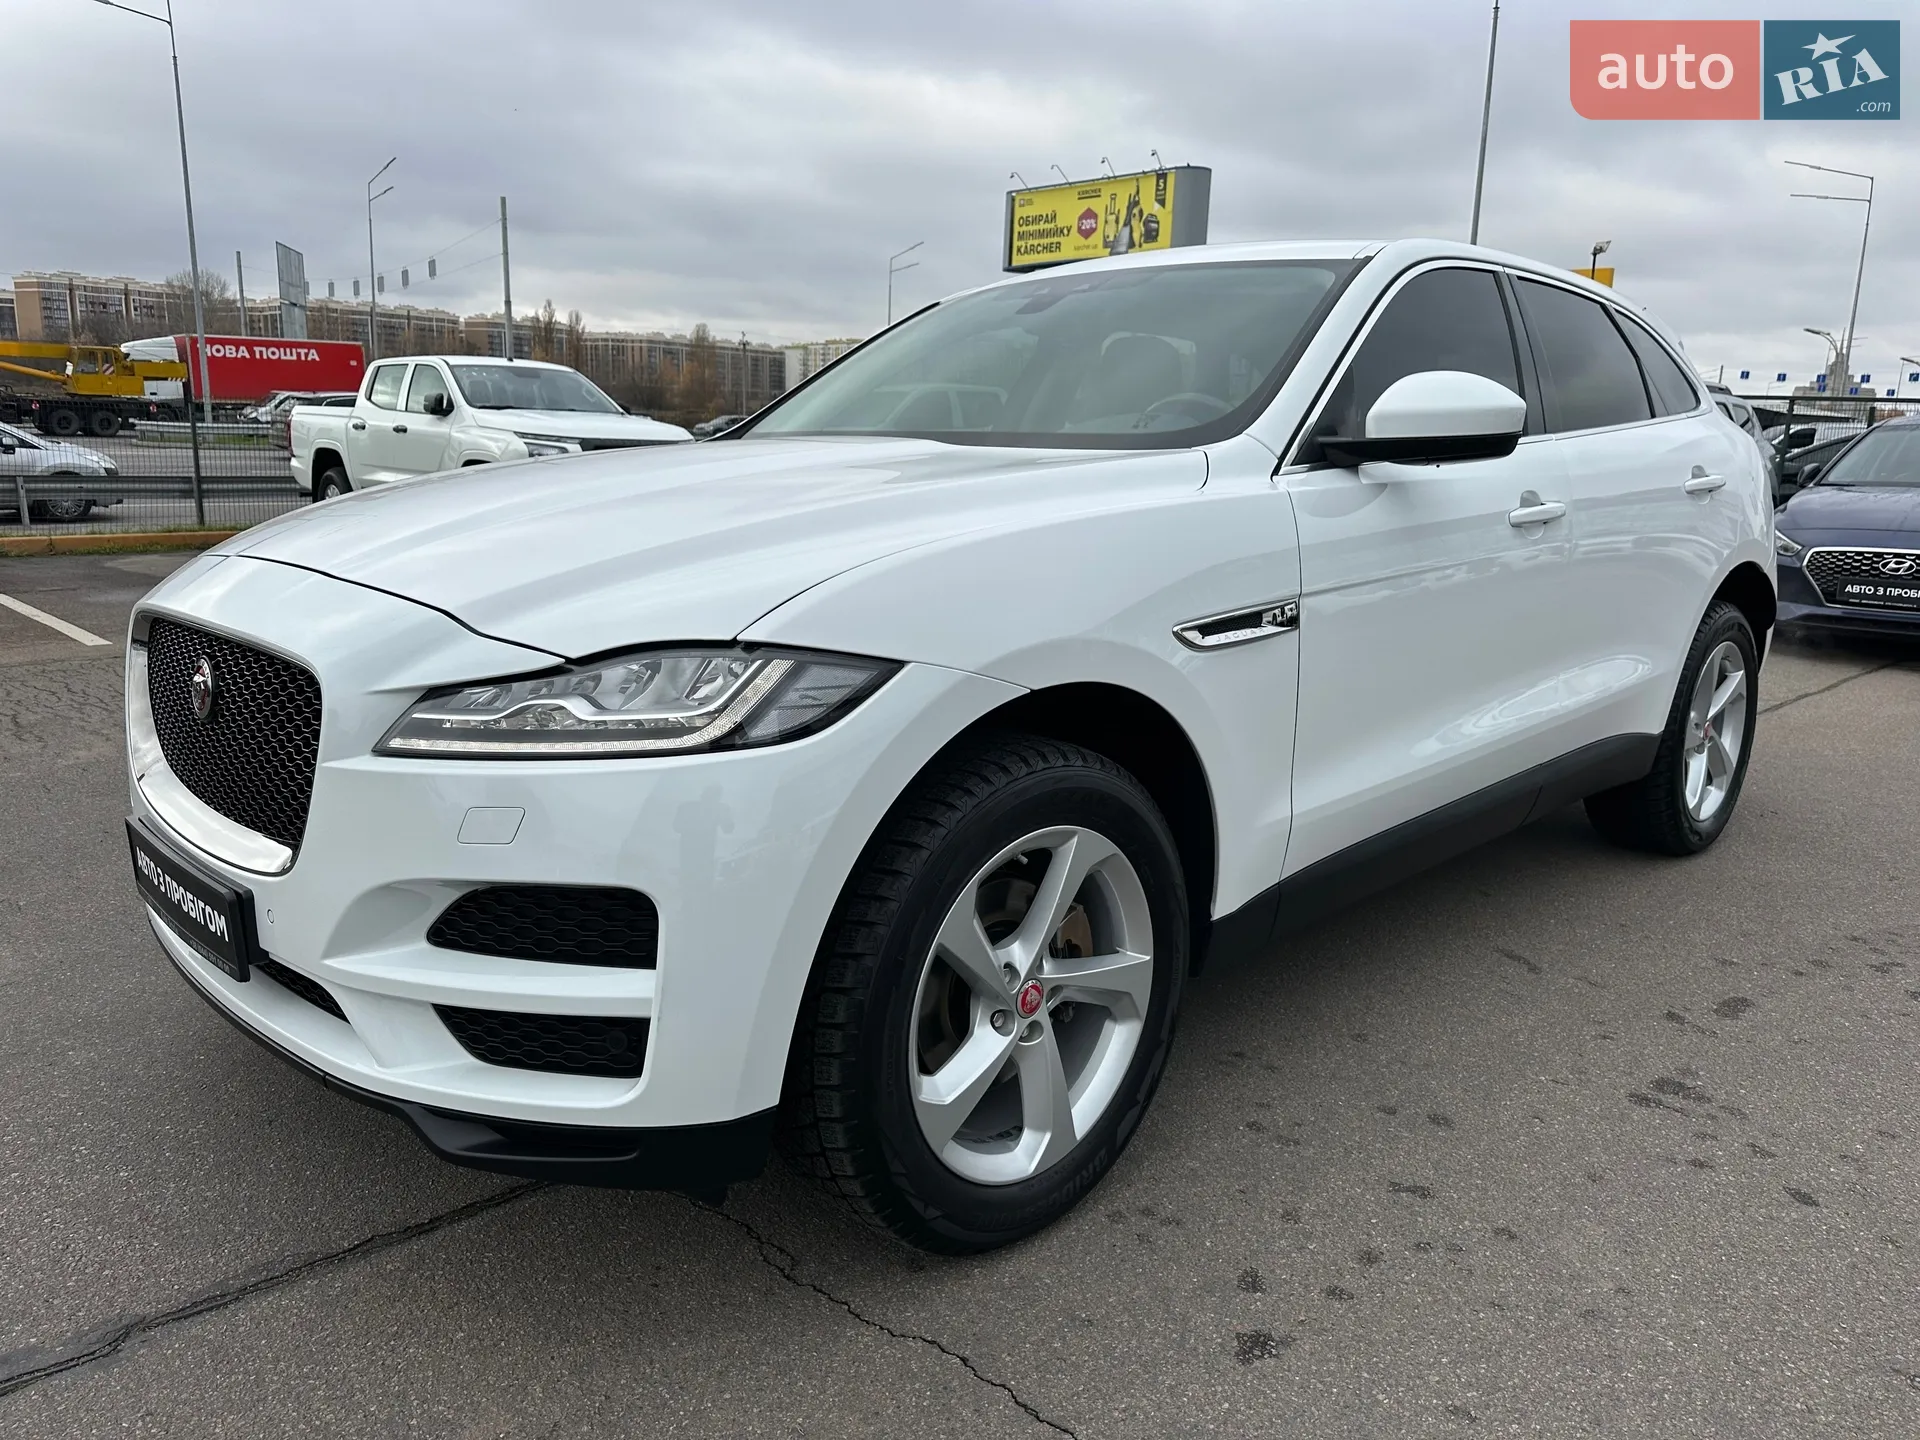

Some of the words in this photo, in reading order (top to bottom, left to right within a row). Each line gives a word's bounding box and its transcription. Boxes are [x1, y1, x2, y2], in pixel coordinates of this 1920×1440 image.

[1018, 210, 1057, 227] ОБИРАЙ
[1017, 225, 1072, 242] МІНІМИЙКУ
[1016, 241, 1062, 256] KÄRCHER
[253, 346, 320, 361] ПОШТА
[1844, 584, 1874, 595] АВТО
[136, 846, 159, 886] АВТО
[165, 873, 229, 942] ПРОБІГОМ
